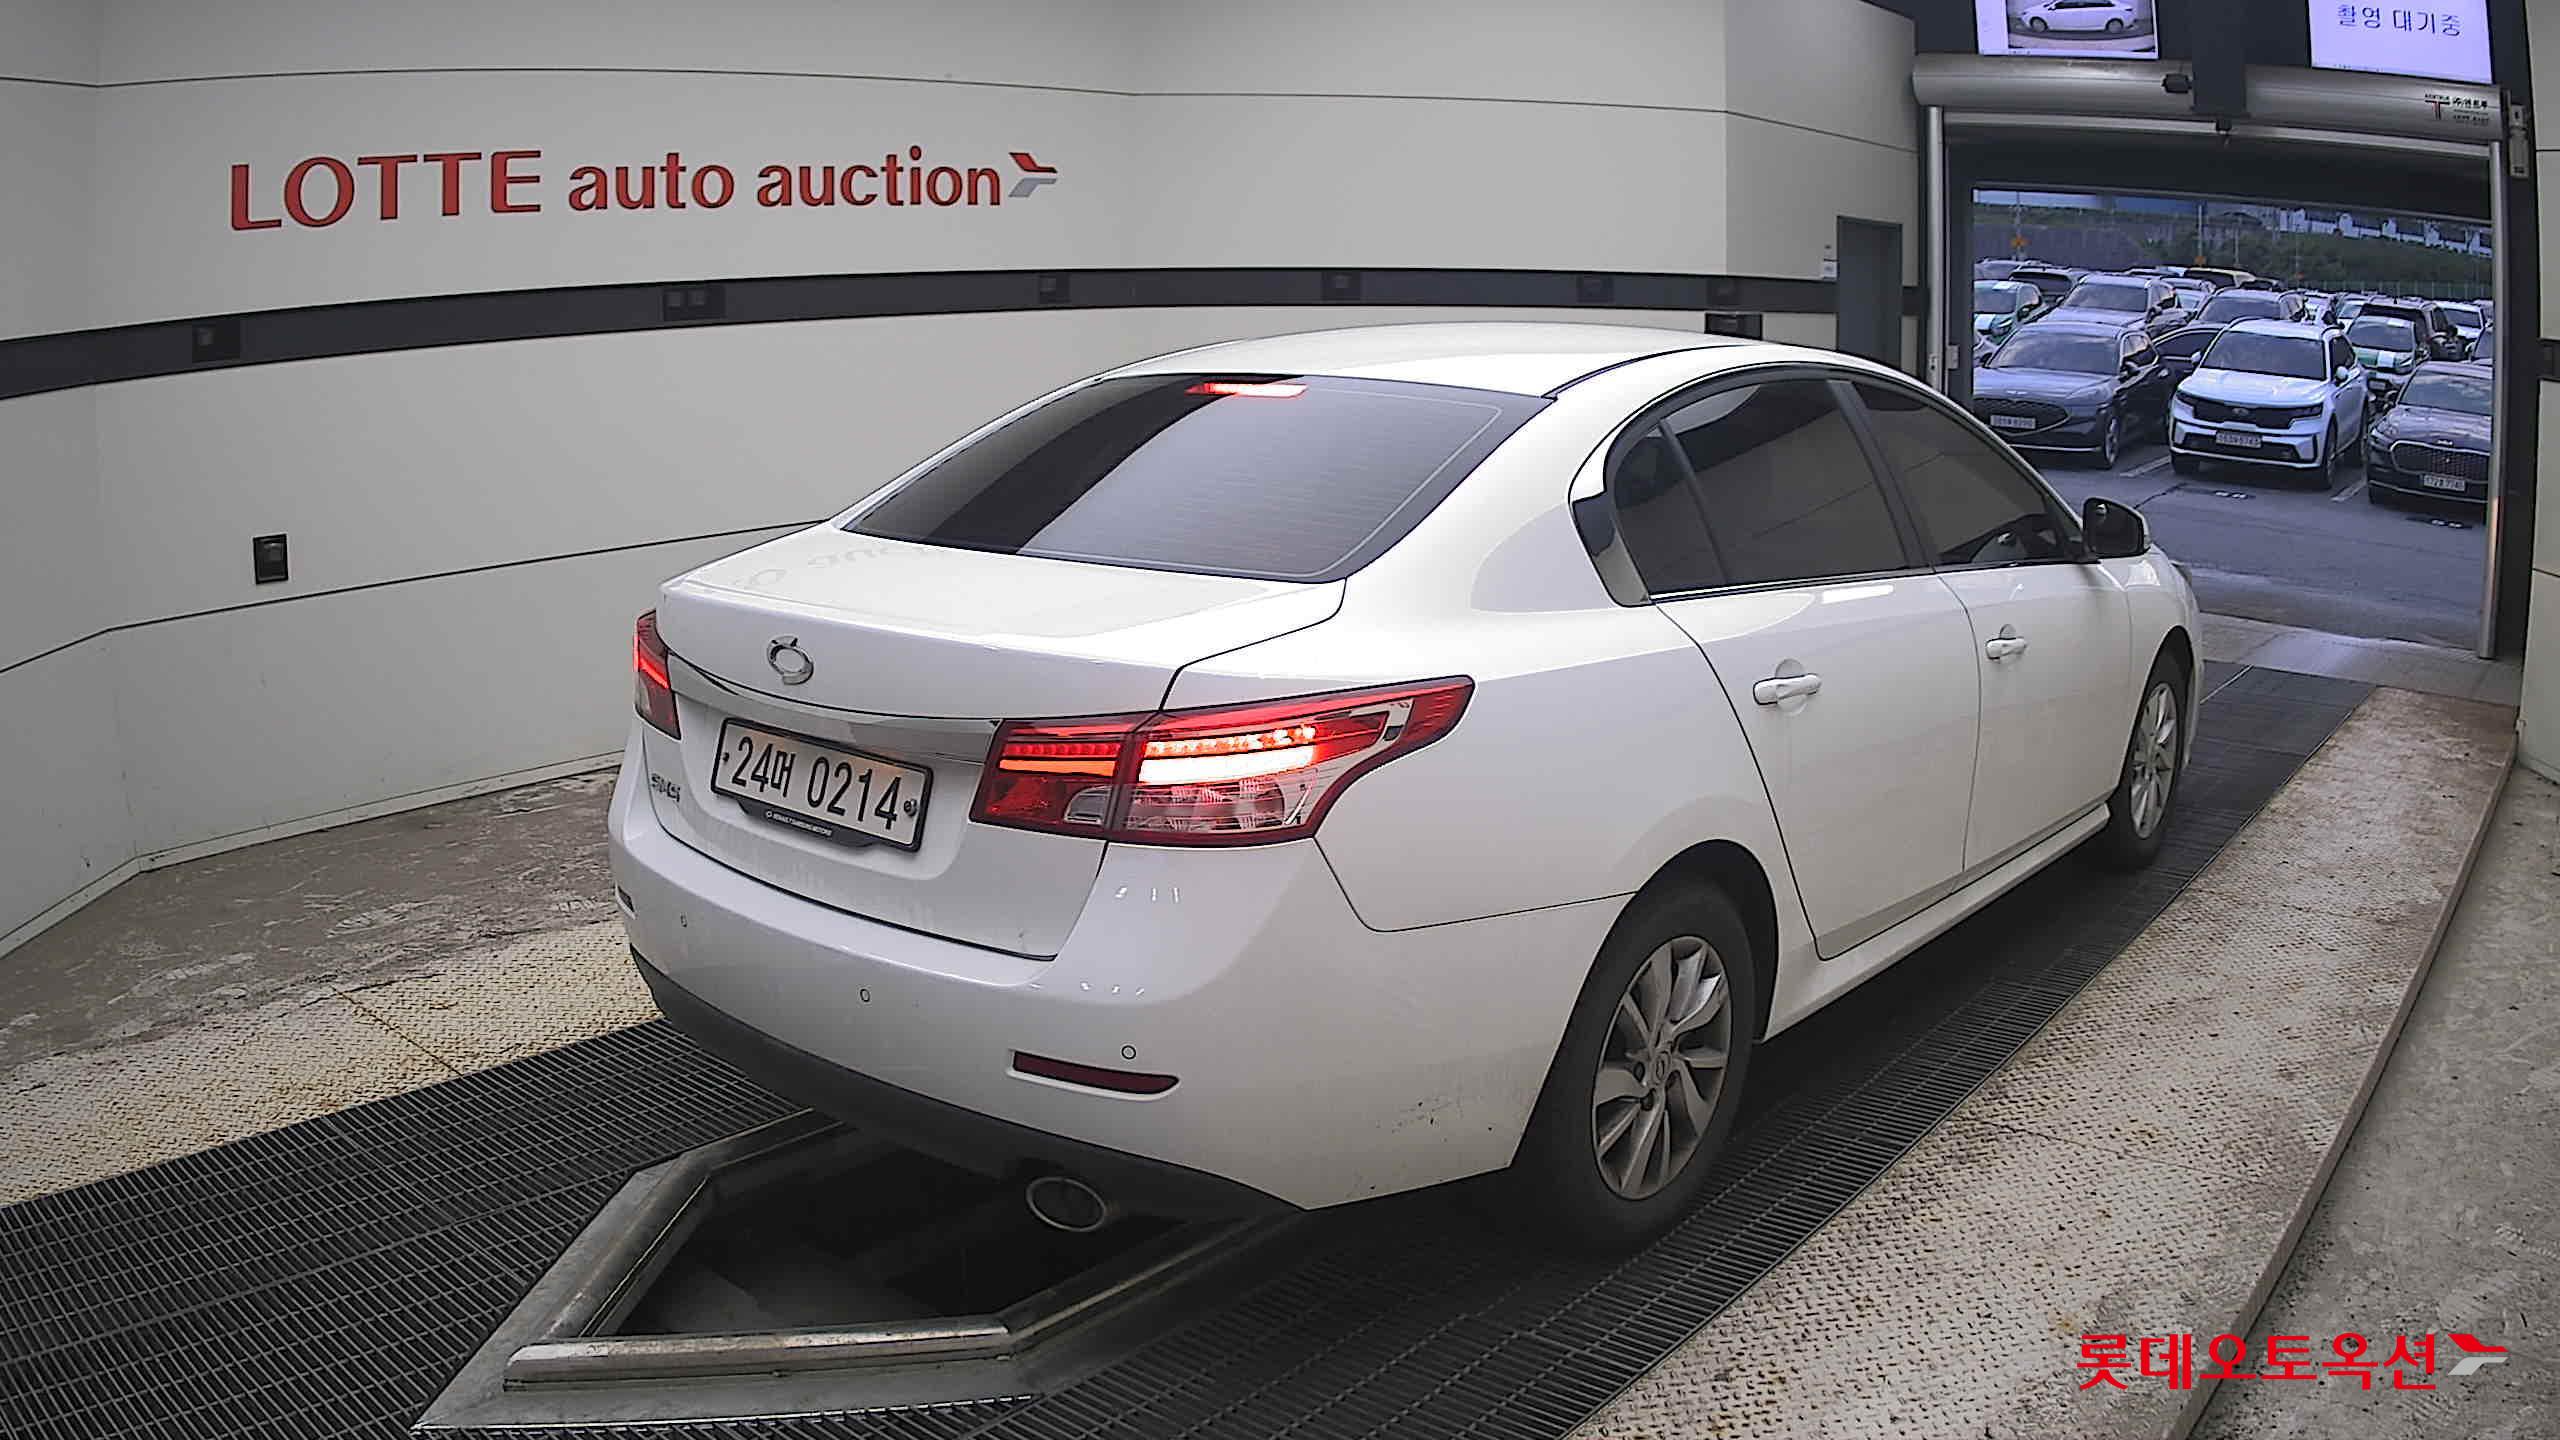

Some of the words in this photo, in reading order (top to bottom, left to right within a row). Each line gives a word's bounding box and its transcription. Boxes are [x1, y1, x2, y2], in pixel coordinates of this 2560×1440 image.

[2337, 5, 2381, 29] 촬영
[2392, 8, 2461, 37] 대기중
[230, 149, 542, 231] LOTTE
[568, 152, 735, 211] auto
[757, 145, 1003, 209] auction
[732, 736, 796, 798] 24머
[807, 756, 902, 830] 0214
